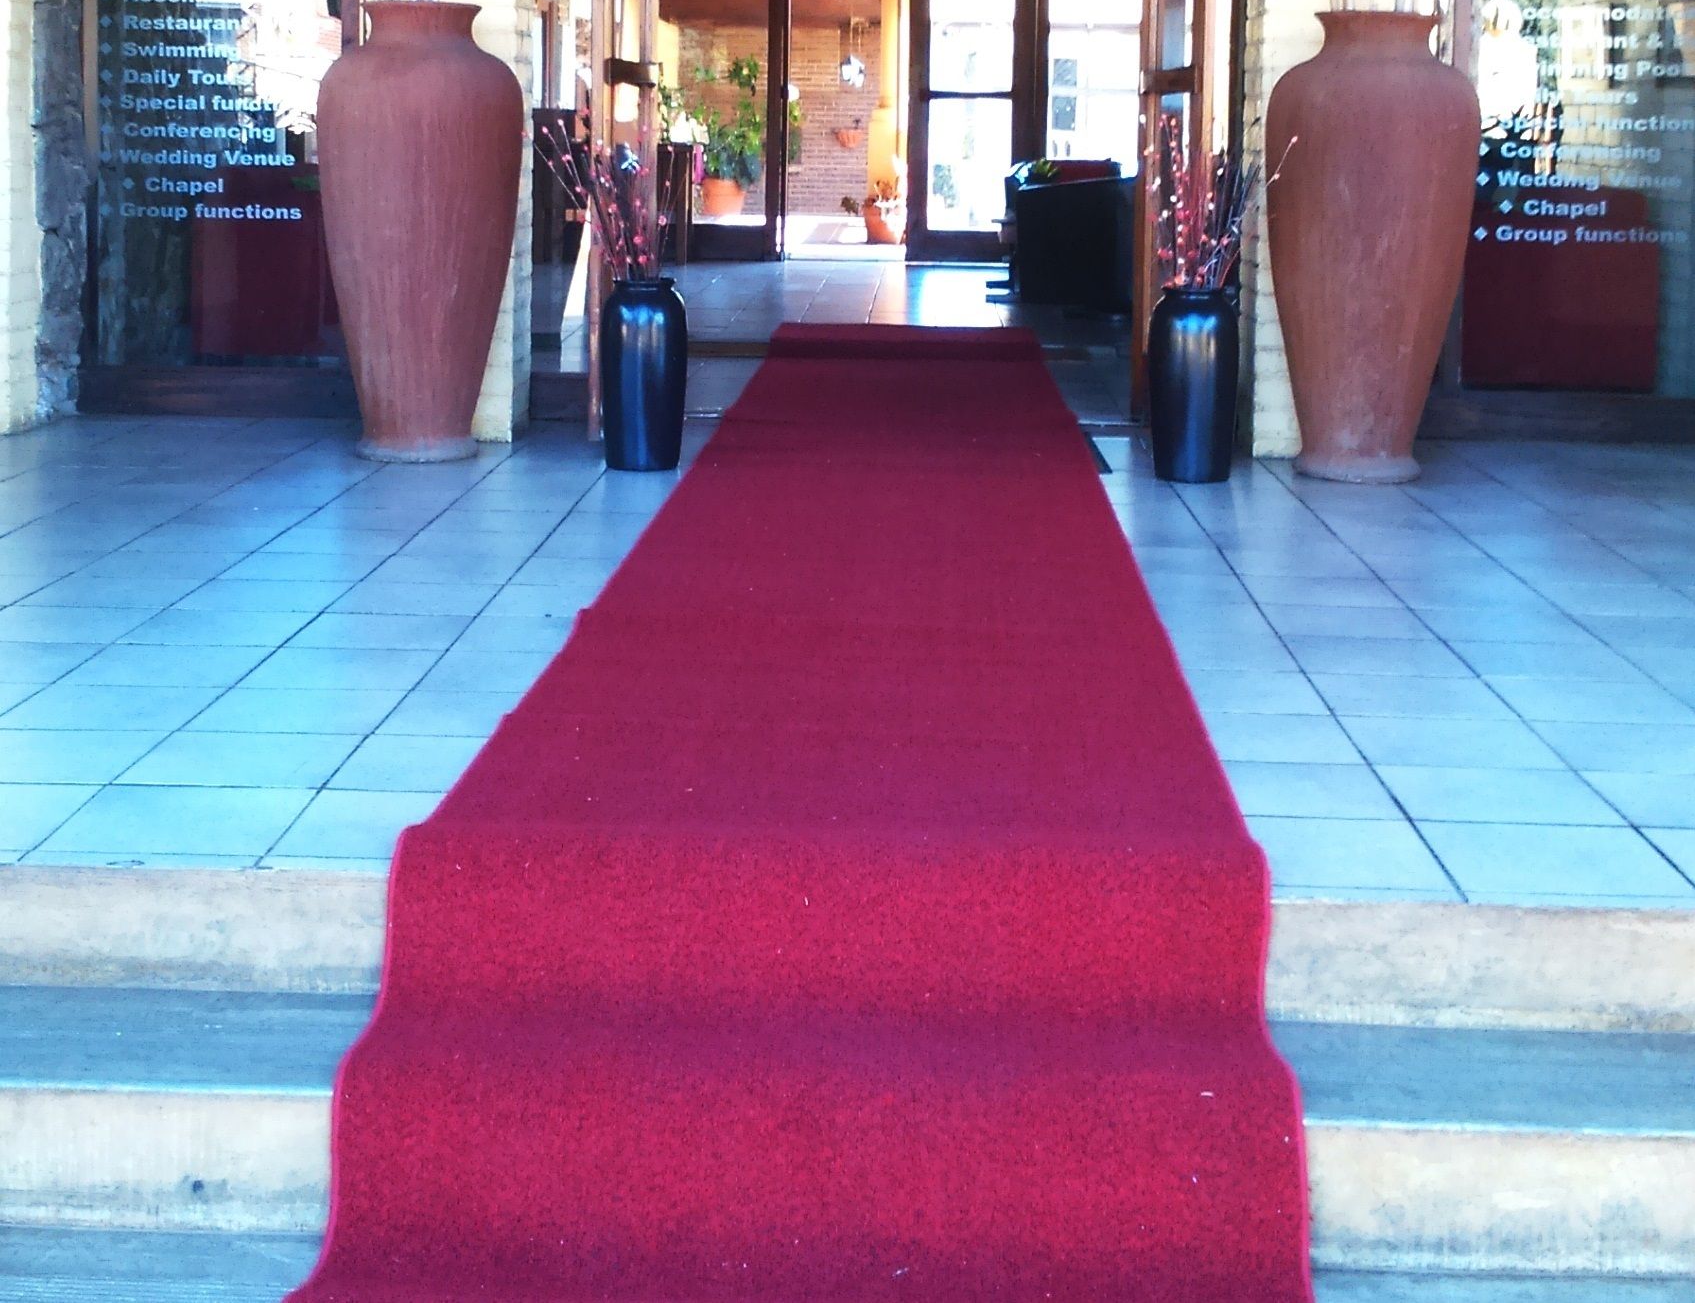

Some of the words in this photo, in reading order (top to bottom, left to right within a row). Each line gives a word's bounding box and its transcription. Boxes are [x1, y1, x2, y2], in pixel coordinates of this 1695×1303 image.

[122, 42, 241, 60] Swimming
[122, 69, 181, 88] Daily
[120, 95, 205, 113] Special
[123, 123, 276, 143] Conferencing
[119, 150, 217, 168] Wedding
[224, 150, 296, 167] Venue
[144, 177, 225, 196] Chapel
[1497, 170, 1600, 191] Wedding
[120, 202, 188, 221] Group
[195, 203, 303, 220] functions
[1522, 199, 1608, 219] Chapel
[1495, 225, 1568, 246] Group
[1575, 226, 1690, 244] functions
